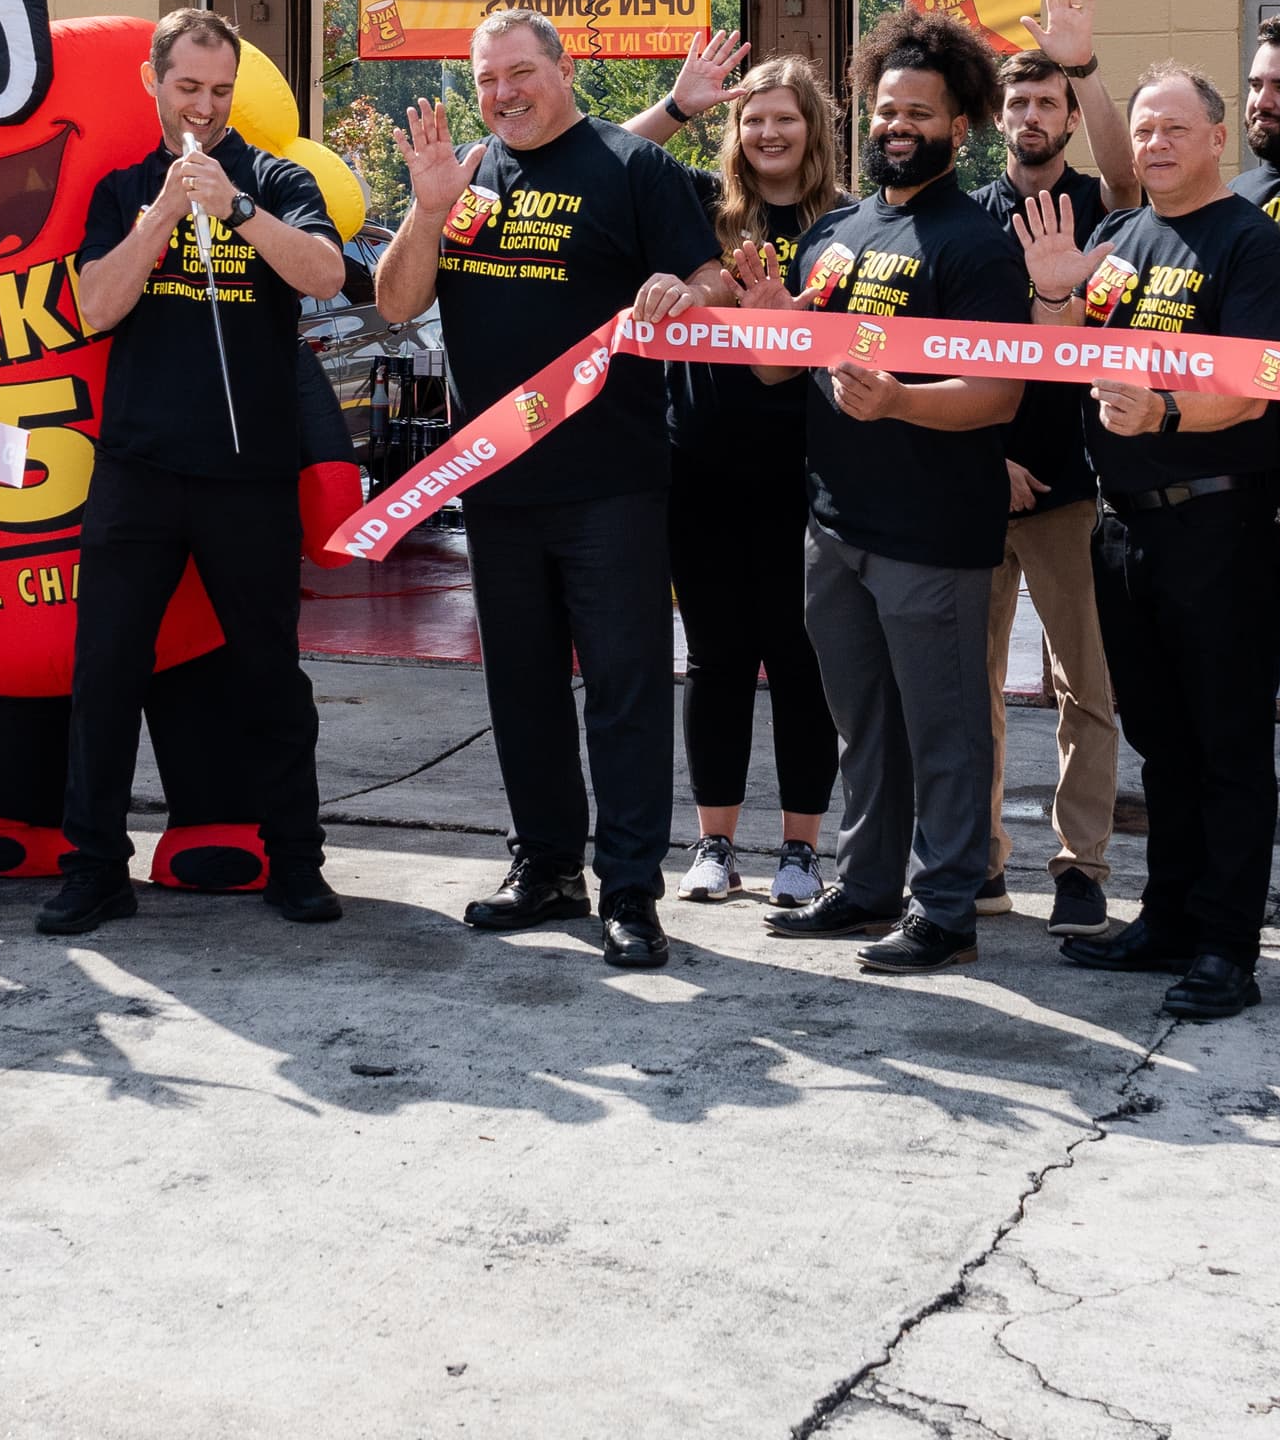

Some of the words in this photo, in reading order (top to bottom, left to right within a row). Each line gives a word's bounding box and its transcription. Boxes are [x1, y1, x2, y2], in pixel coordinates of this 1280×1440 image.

[460, 189, 492, 214] TAKE
[507, 189, 582, 218] 300TH
[451, 207, 477, 230] 5
[502, 220, 573, 239] FRANCHISE
[500, 235, 560, 252] LOCATION
[463, 259, 517, 278] FRIENDLY.
[520, 265, 569, 281] SIMPLE.
[858, 250, 920, 281] 300TH
[153, 282, 206, 301] FRIENDLY.
[1088, 281, 1112, 306] 5
[1144, 266, 1204, 297] 300TH
[665, 322, 813, 351] OPENING
[923, 336, 1043, 364] GRAND
[1054, 343, 1214, 376] OPENING
[386, 437, 498, 520] OPENING
